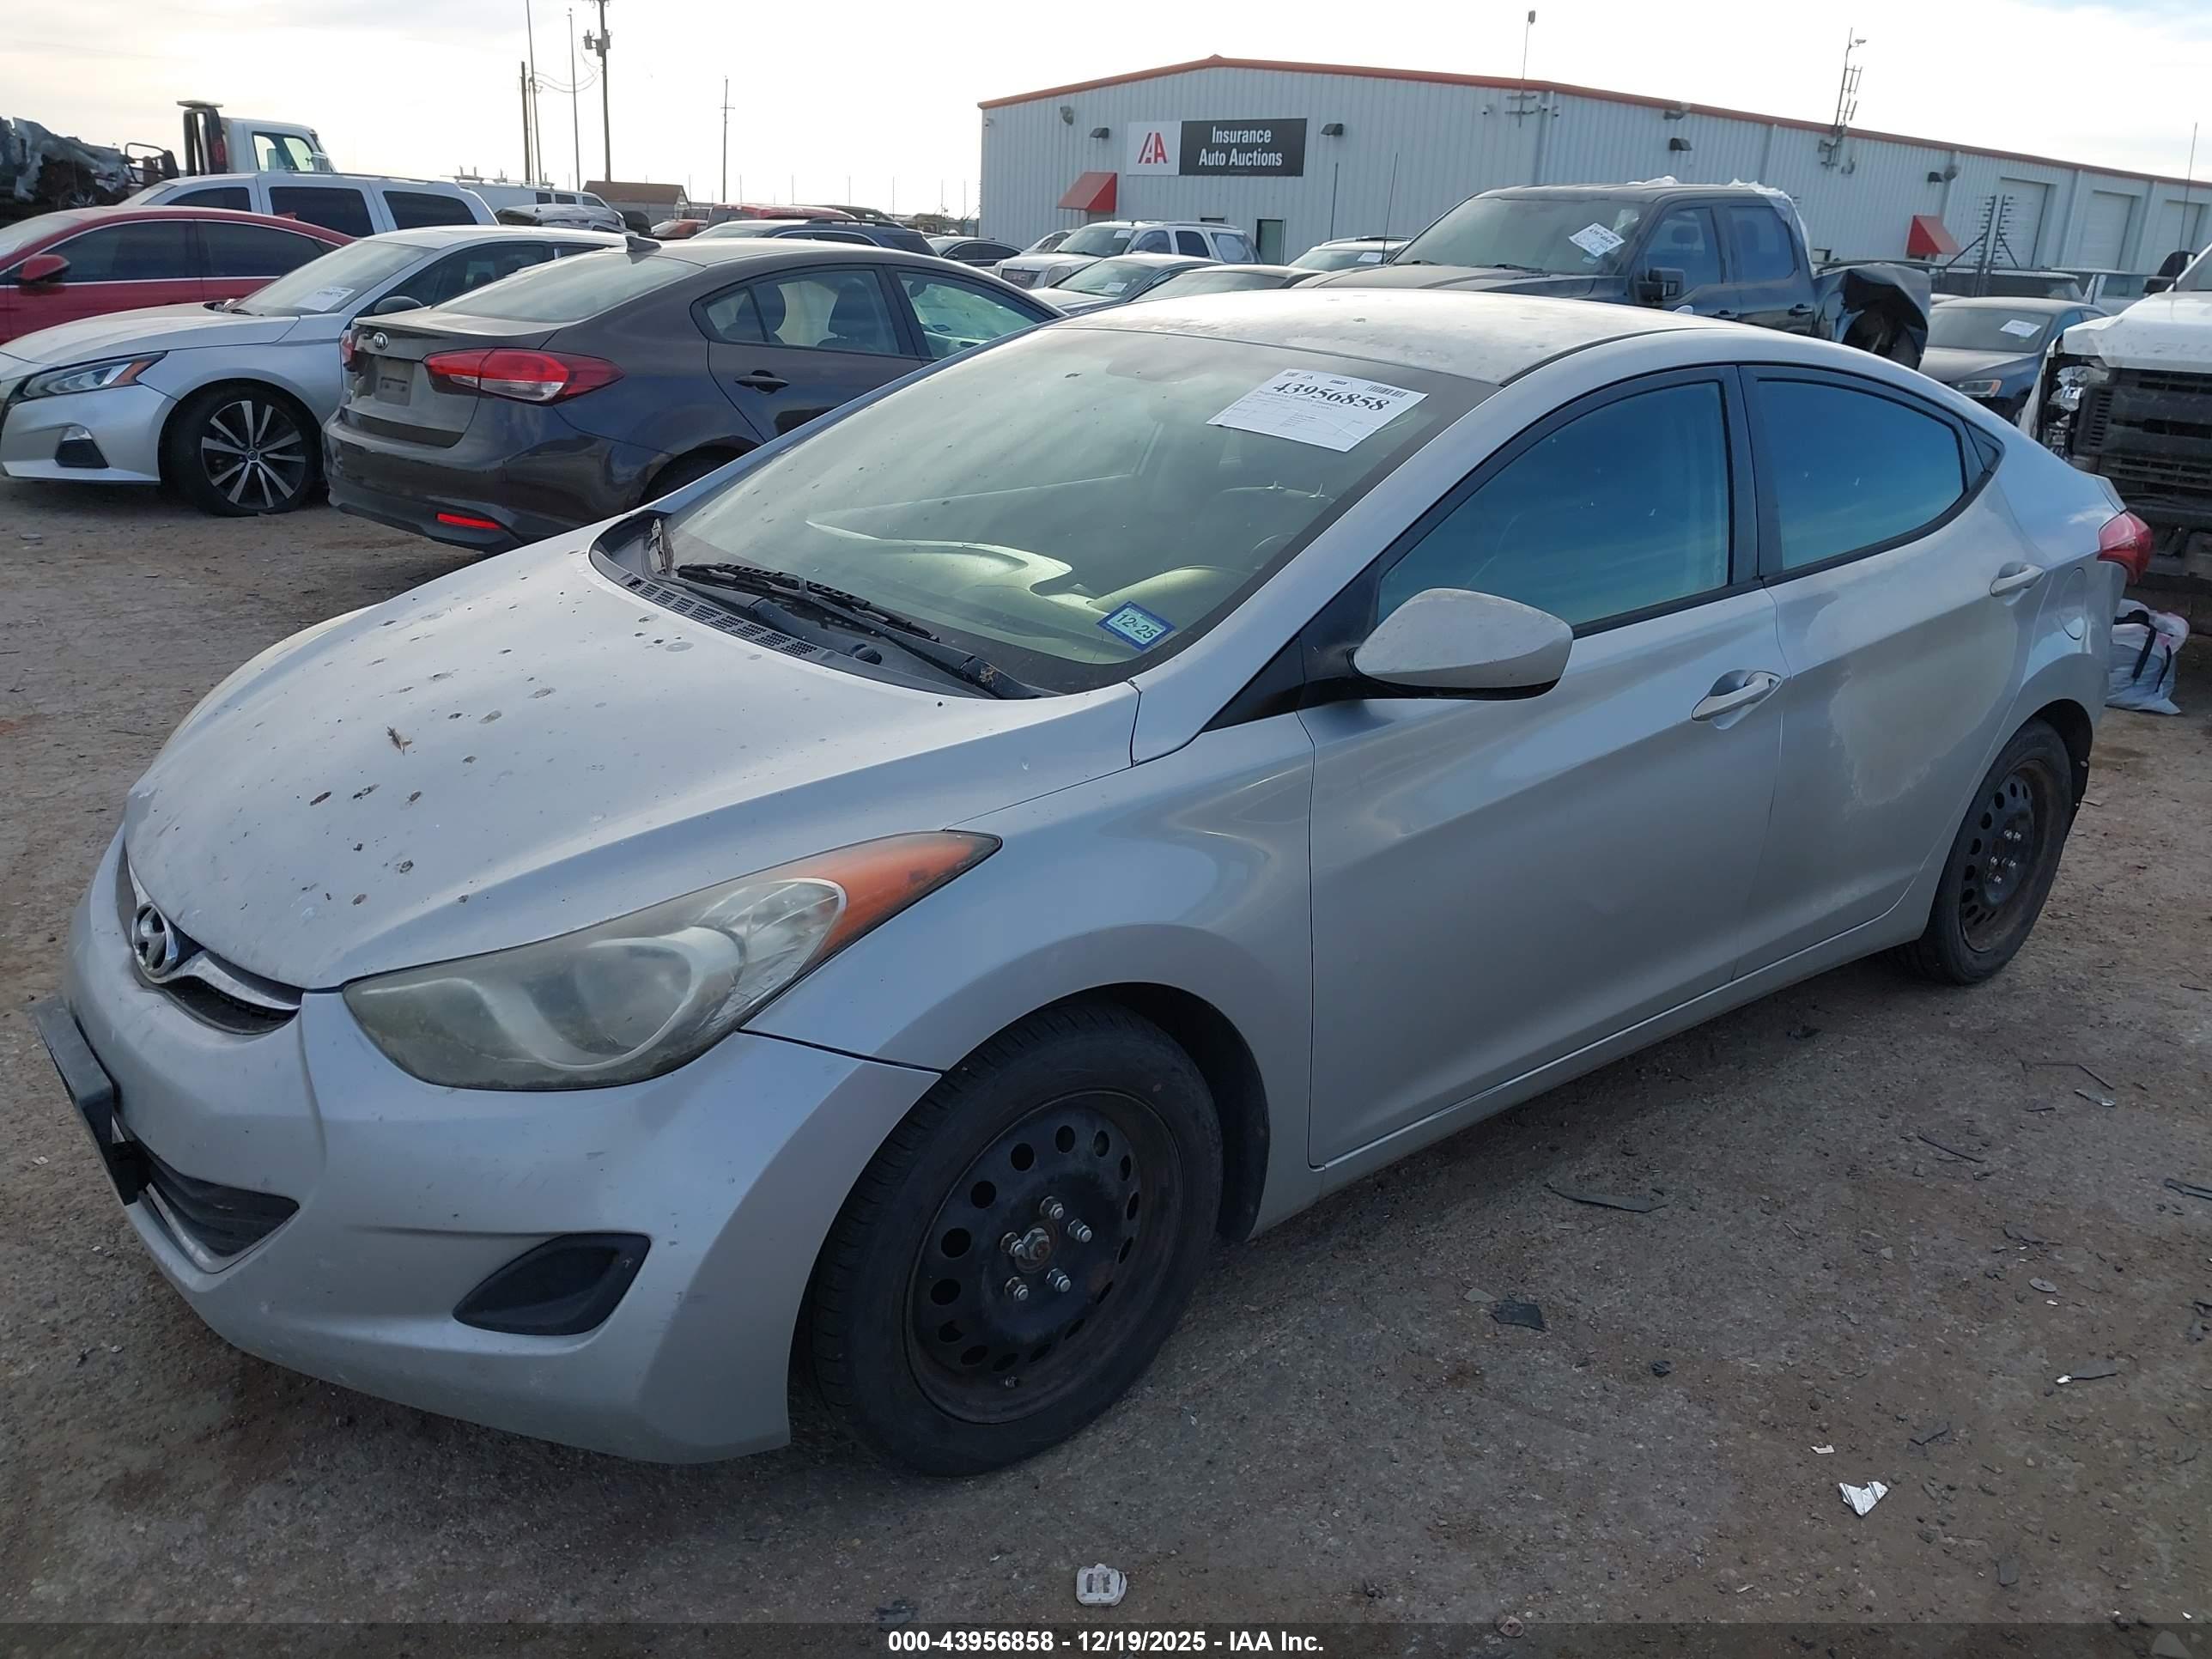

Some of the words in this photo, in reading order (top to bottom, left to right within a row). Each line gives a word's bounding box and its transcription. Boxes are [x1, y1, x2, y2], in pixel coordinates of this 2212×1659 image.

[1212, 125, 1272, 144] Insurance
[1199, 148, 1226, 167] Auto
[1229, 148, 1283, 167] Auctions
[1273, 381, 1390, 411] 43956858
